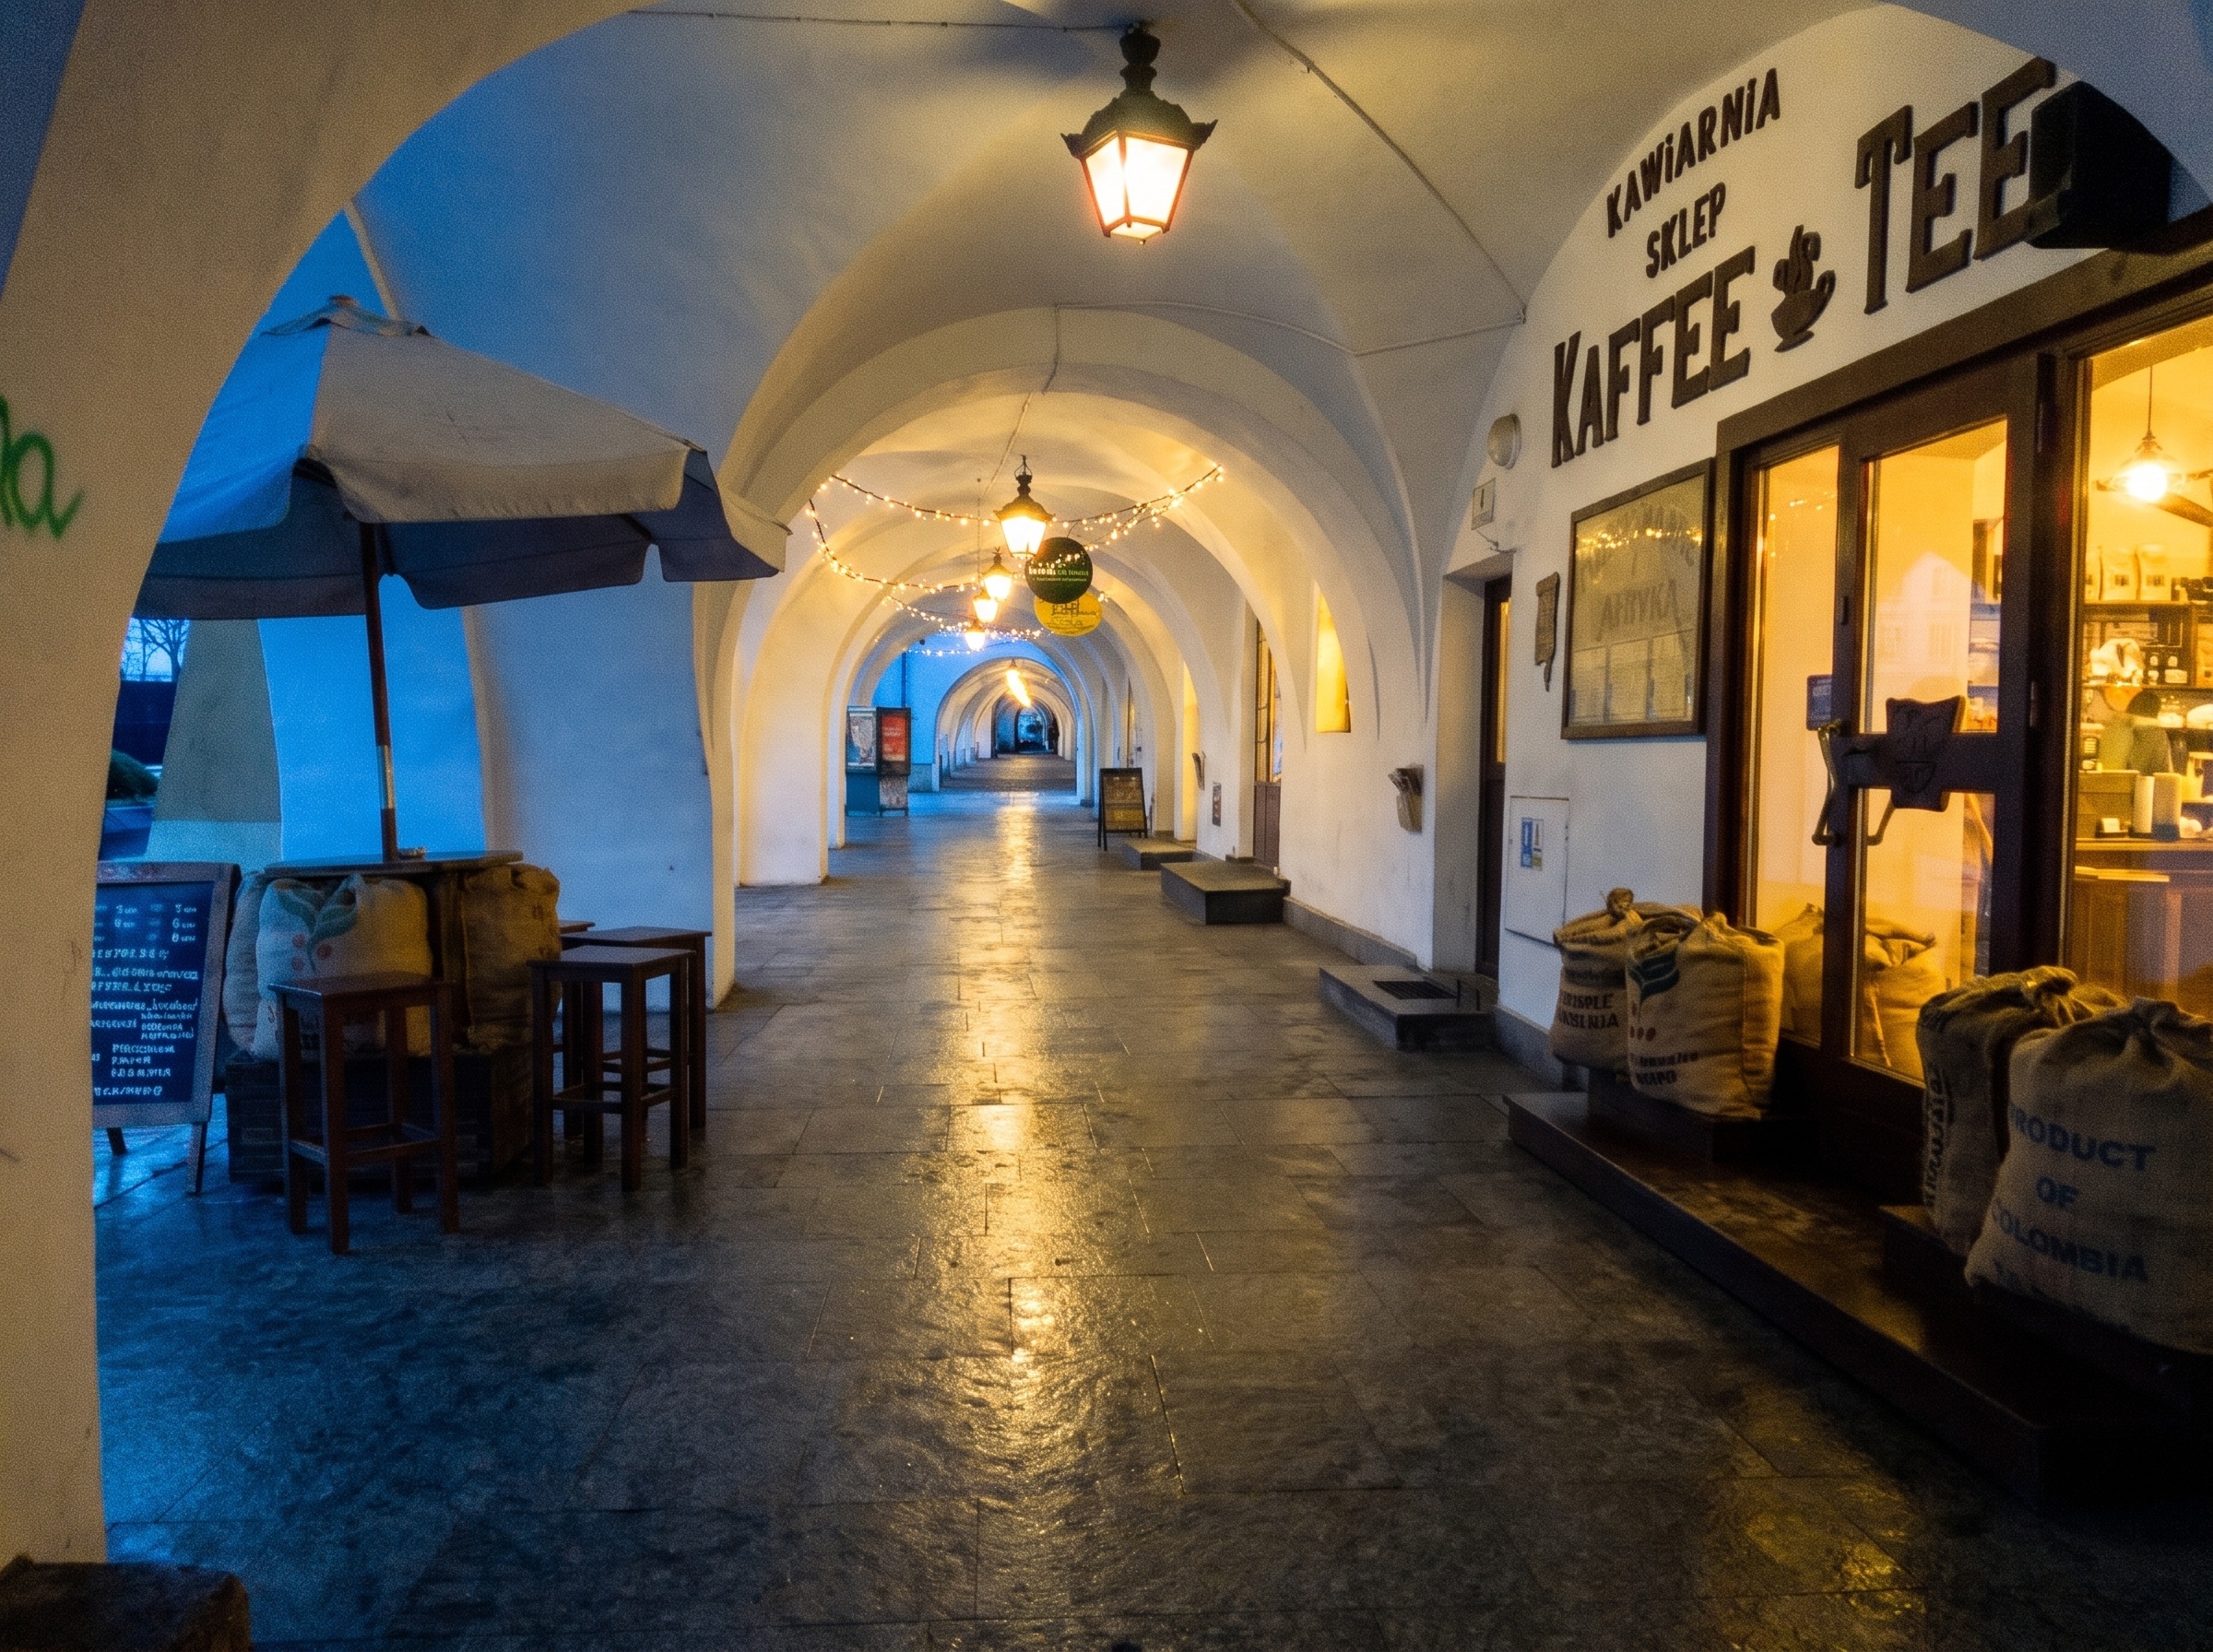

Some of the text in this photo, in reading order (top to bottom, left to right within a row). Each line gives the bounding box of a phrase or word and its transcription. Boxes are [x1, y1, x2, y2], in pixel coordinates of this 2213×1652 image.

[1552, 57, 2056, 469] KAFFEE TEE
[1645, 182, 1726, 278] SKLEP
[2036, 1175, 2079, 1209] OF
